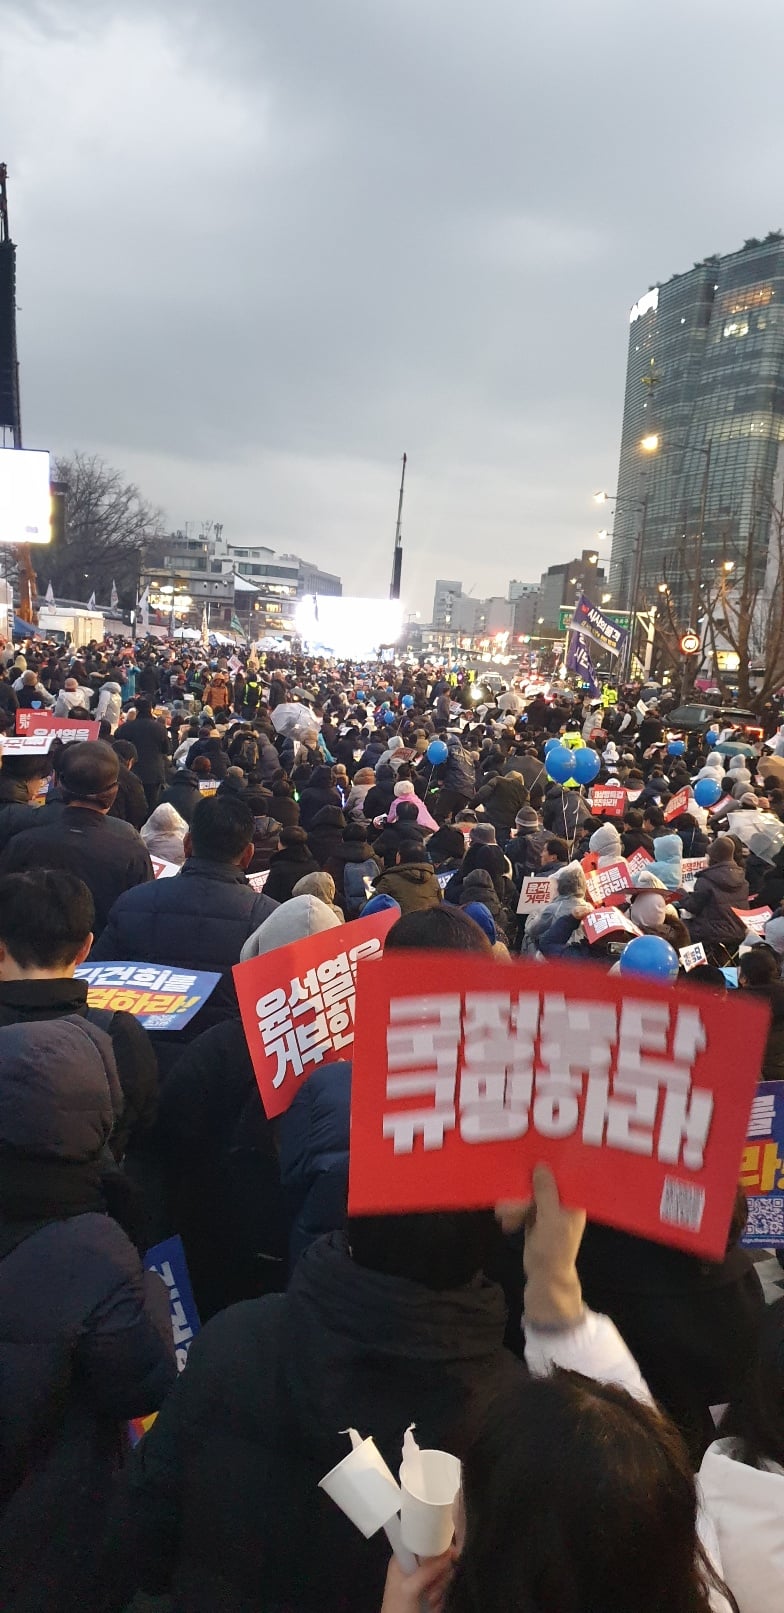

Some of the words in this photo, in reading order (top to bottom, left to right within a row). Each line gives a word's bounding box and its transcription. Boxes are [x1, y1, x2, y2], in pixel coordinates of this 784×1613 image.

[526, 882, 550, 894] 윤석
[264, 995, 355, 1088] 거부한
[386, 991, 707, 1090] 국정농단
[382, 1070, 714, 1171] 규명하라!
